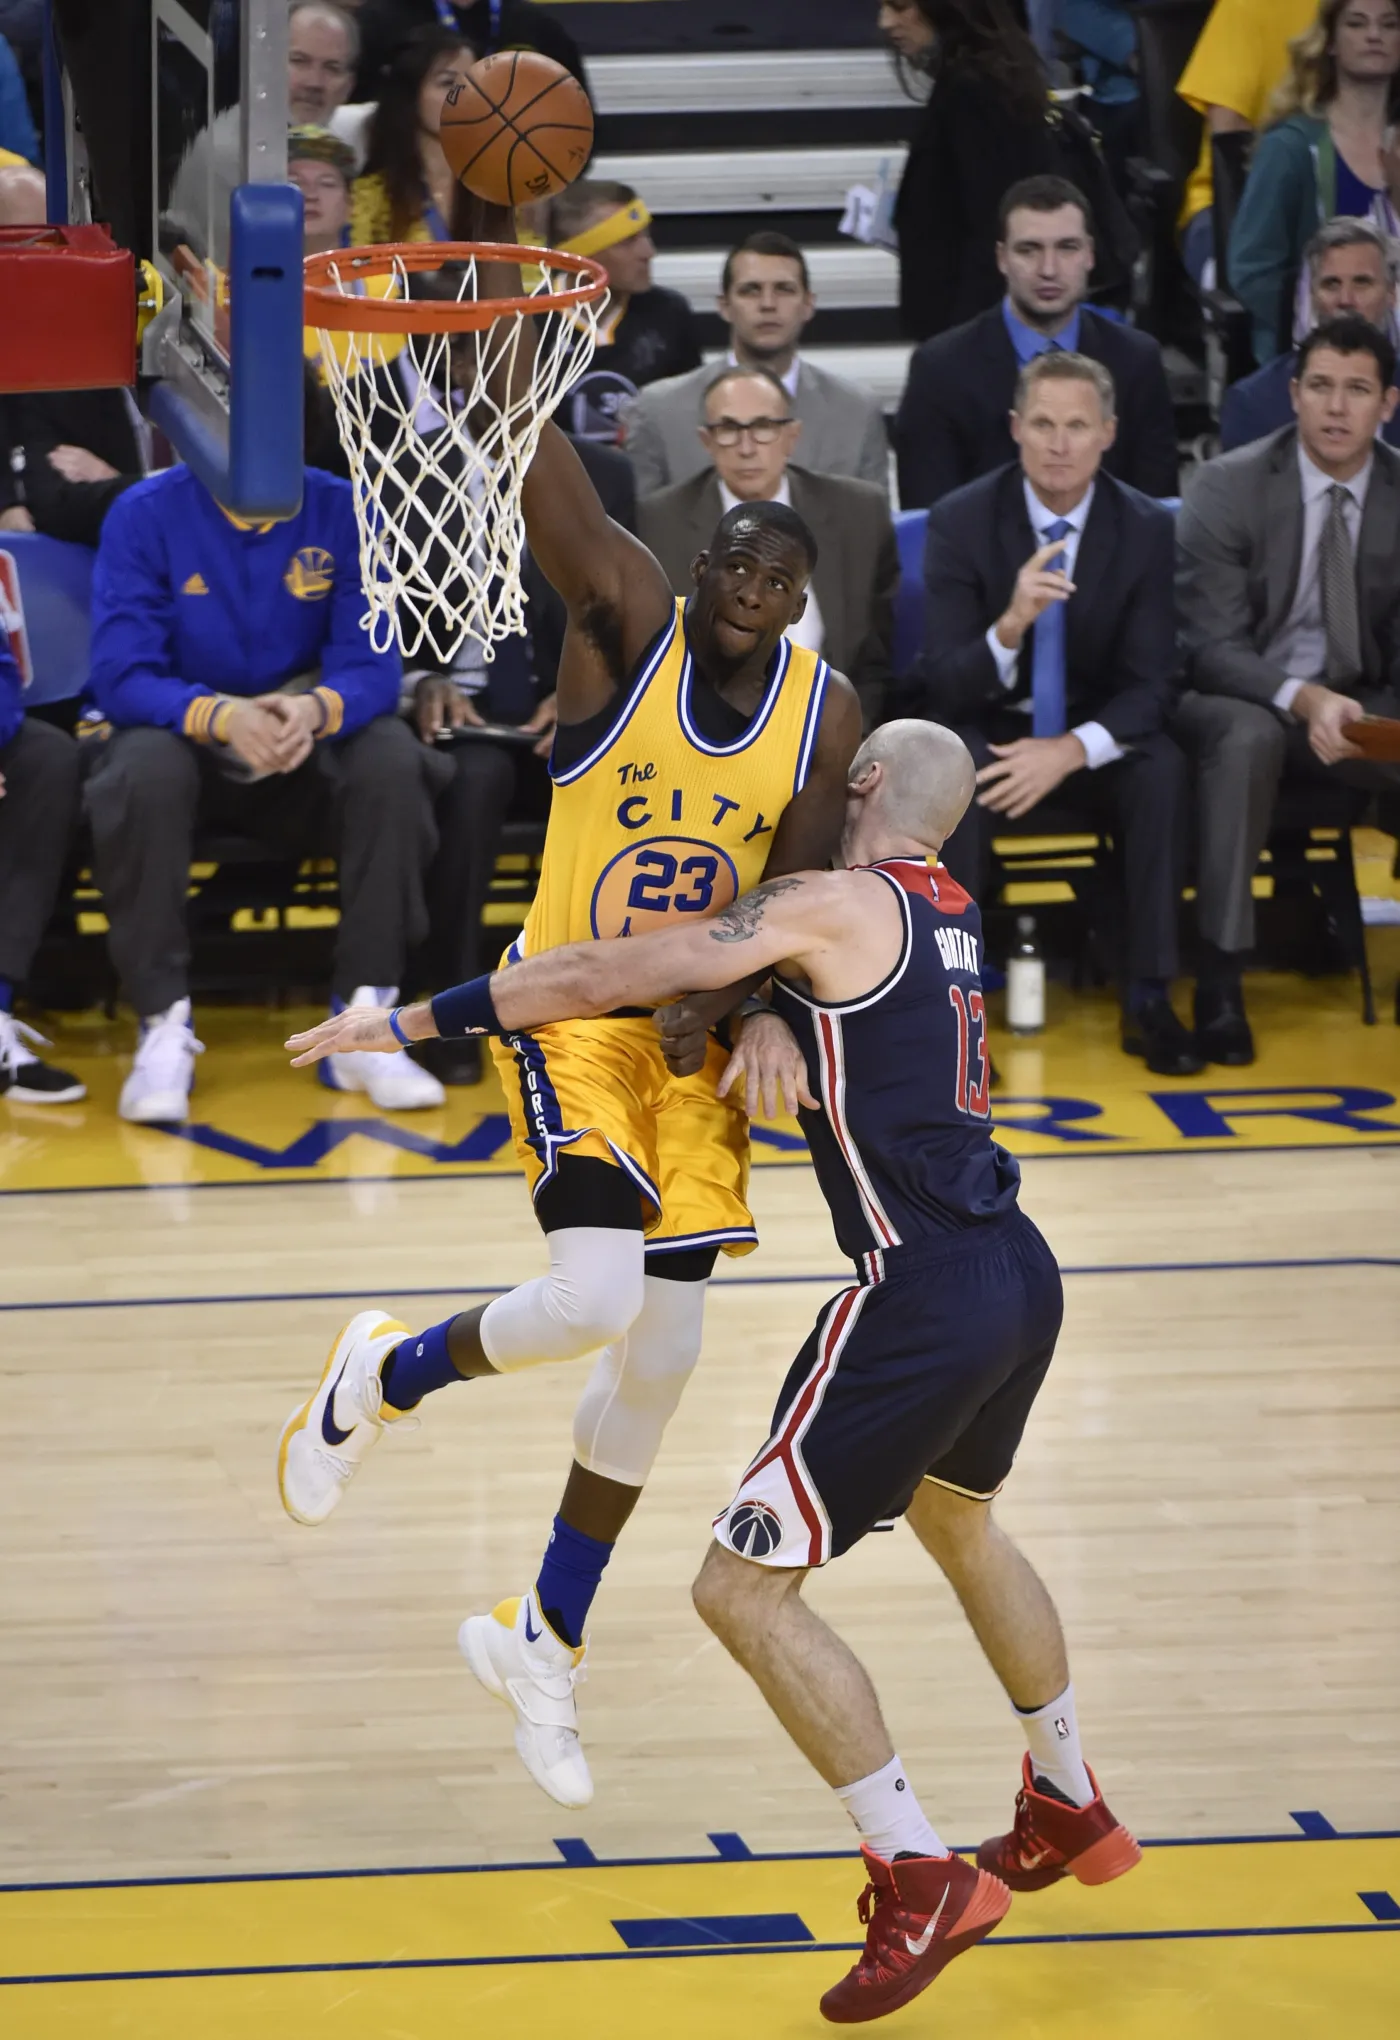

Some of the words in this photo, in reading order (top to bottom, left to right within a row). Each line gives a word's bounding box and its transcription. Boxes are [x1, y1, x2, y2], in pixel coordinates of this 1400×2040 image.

[617, 762, 658, 785] The
[616, 789, 773, 843] CITY
[627, 849, 719, 913] 23
[934, 926, 980, 967] GORTAT
[949, 984, 991, 1120] 13
